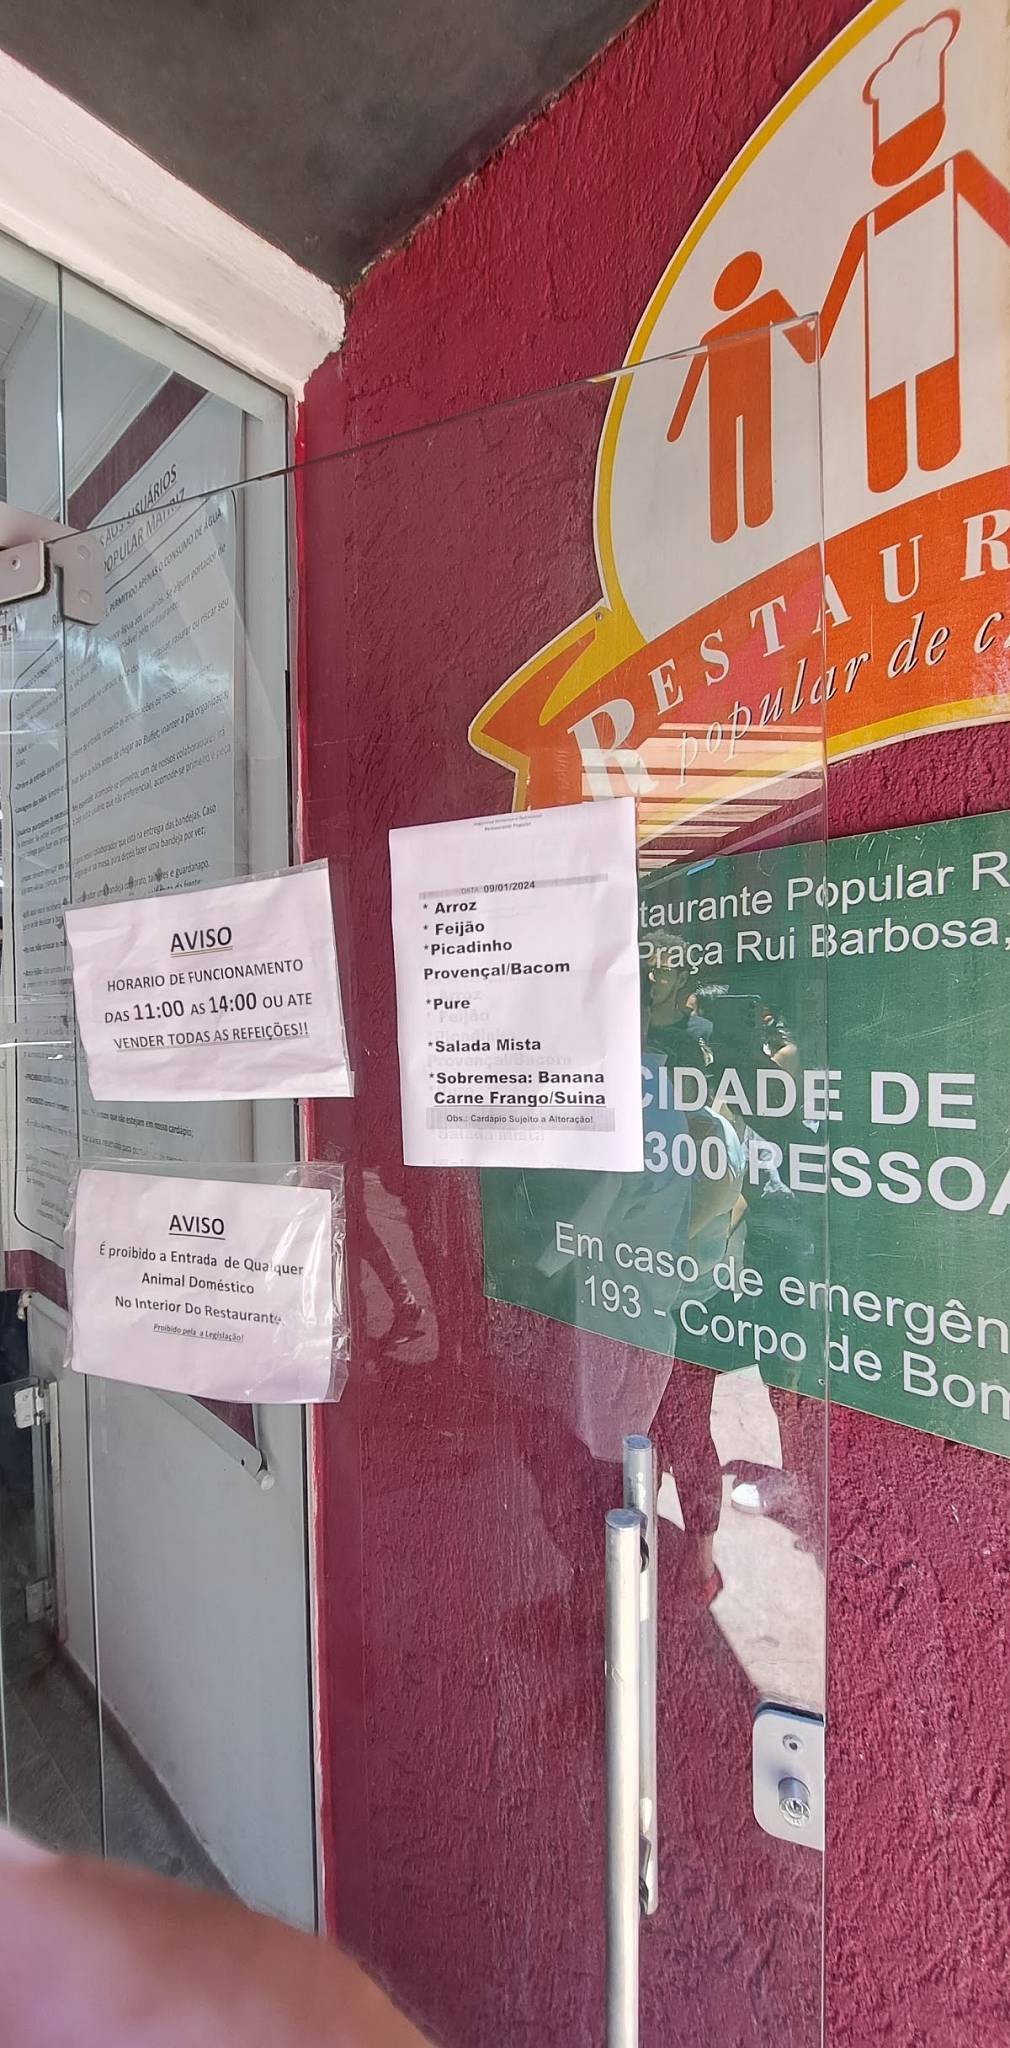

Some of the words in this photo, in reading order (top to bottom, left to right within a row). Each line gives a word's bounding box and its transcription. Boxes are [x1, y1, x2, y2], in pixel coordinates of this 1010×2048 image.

[675, 652, 870, 789] popular
[886, 610, 951, 680] de
[974, 612, 1010, 654] c
[484, 881, 535, 894] 09/01/2024
[787, 864, 954, 914] Popular
[435, 901, 477, 914] Arroz
[171, 926, 232, 953] AVISO
[435, 922, 485, 937] Feijão
[638, 941, 723, 975] Praça
[736, 927, 795, 963] Rui
[811, 917, 1010, 957] Barbosa,
[107, 974, 165, 992] HORARIO
[169, 973, 186, 986] DE
[189, 958, 304, 984] FUNCIONAMENTO
[424, 962, 570, 980] Provençal/Bacom
[104, 1010, 130, 1024] DAS
[133, 999, 185, 1021] 11:00
[190, 1004, 206, 1016] AS
[209, 992, 258, 1015] 14:00
[263, 996, 284, 1009] OU
[287, 992, 313, 1006] ATE
[114, 1033, 165, 1049] VENDER
[167, 1031, 211, 1046] TODAS
[214, 1030, 229, 1042] AS
[233, 1021, 308, 1041] REFEIÇÕES!!
[496, 1038, 541, 1051] Mista
[538, 1070, 605, 1084] Banana
[434, 1091, 485, 1105] Carne
[490, 1091, 606, 1107] Frango/Suina
[871, 1072, 976, 1131] DE
[509, 1115, 539, 1125] Sujeito
[748, 1138, 1010, 1216] PESSO
[169, 1214, 225, 1236] AVISO
[99, 1241, 106, 1255] É
[108, 1245, 156, 1261] proibido
[160, 1253, 167, 1262] a
[171, 1250, 217, 1267] Entrada
[224, 1256, 240, 1269] de
[555, 1221, 603, 1262] Em
[615, 1240, 699, 1283] caso
[713, 1256, 763, 1297] de
[142, 1272, 185, 1287] Animal
[189, 1276, 255, 1294] Doméstico
[115, 1296, 131, 1308] No
[135, 1298, 181, 1313] Interior
[185, 1302, 201, 1315] Do
[154, 1323, 181, 1333] Proibido
[183, 1328, 196, 1336] pela
[583, 1275, 641, 1319] 193
[680, 1299, 806, 1362] Corpo
[829, 1335, 882, 1382] de
